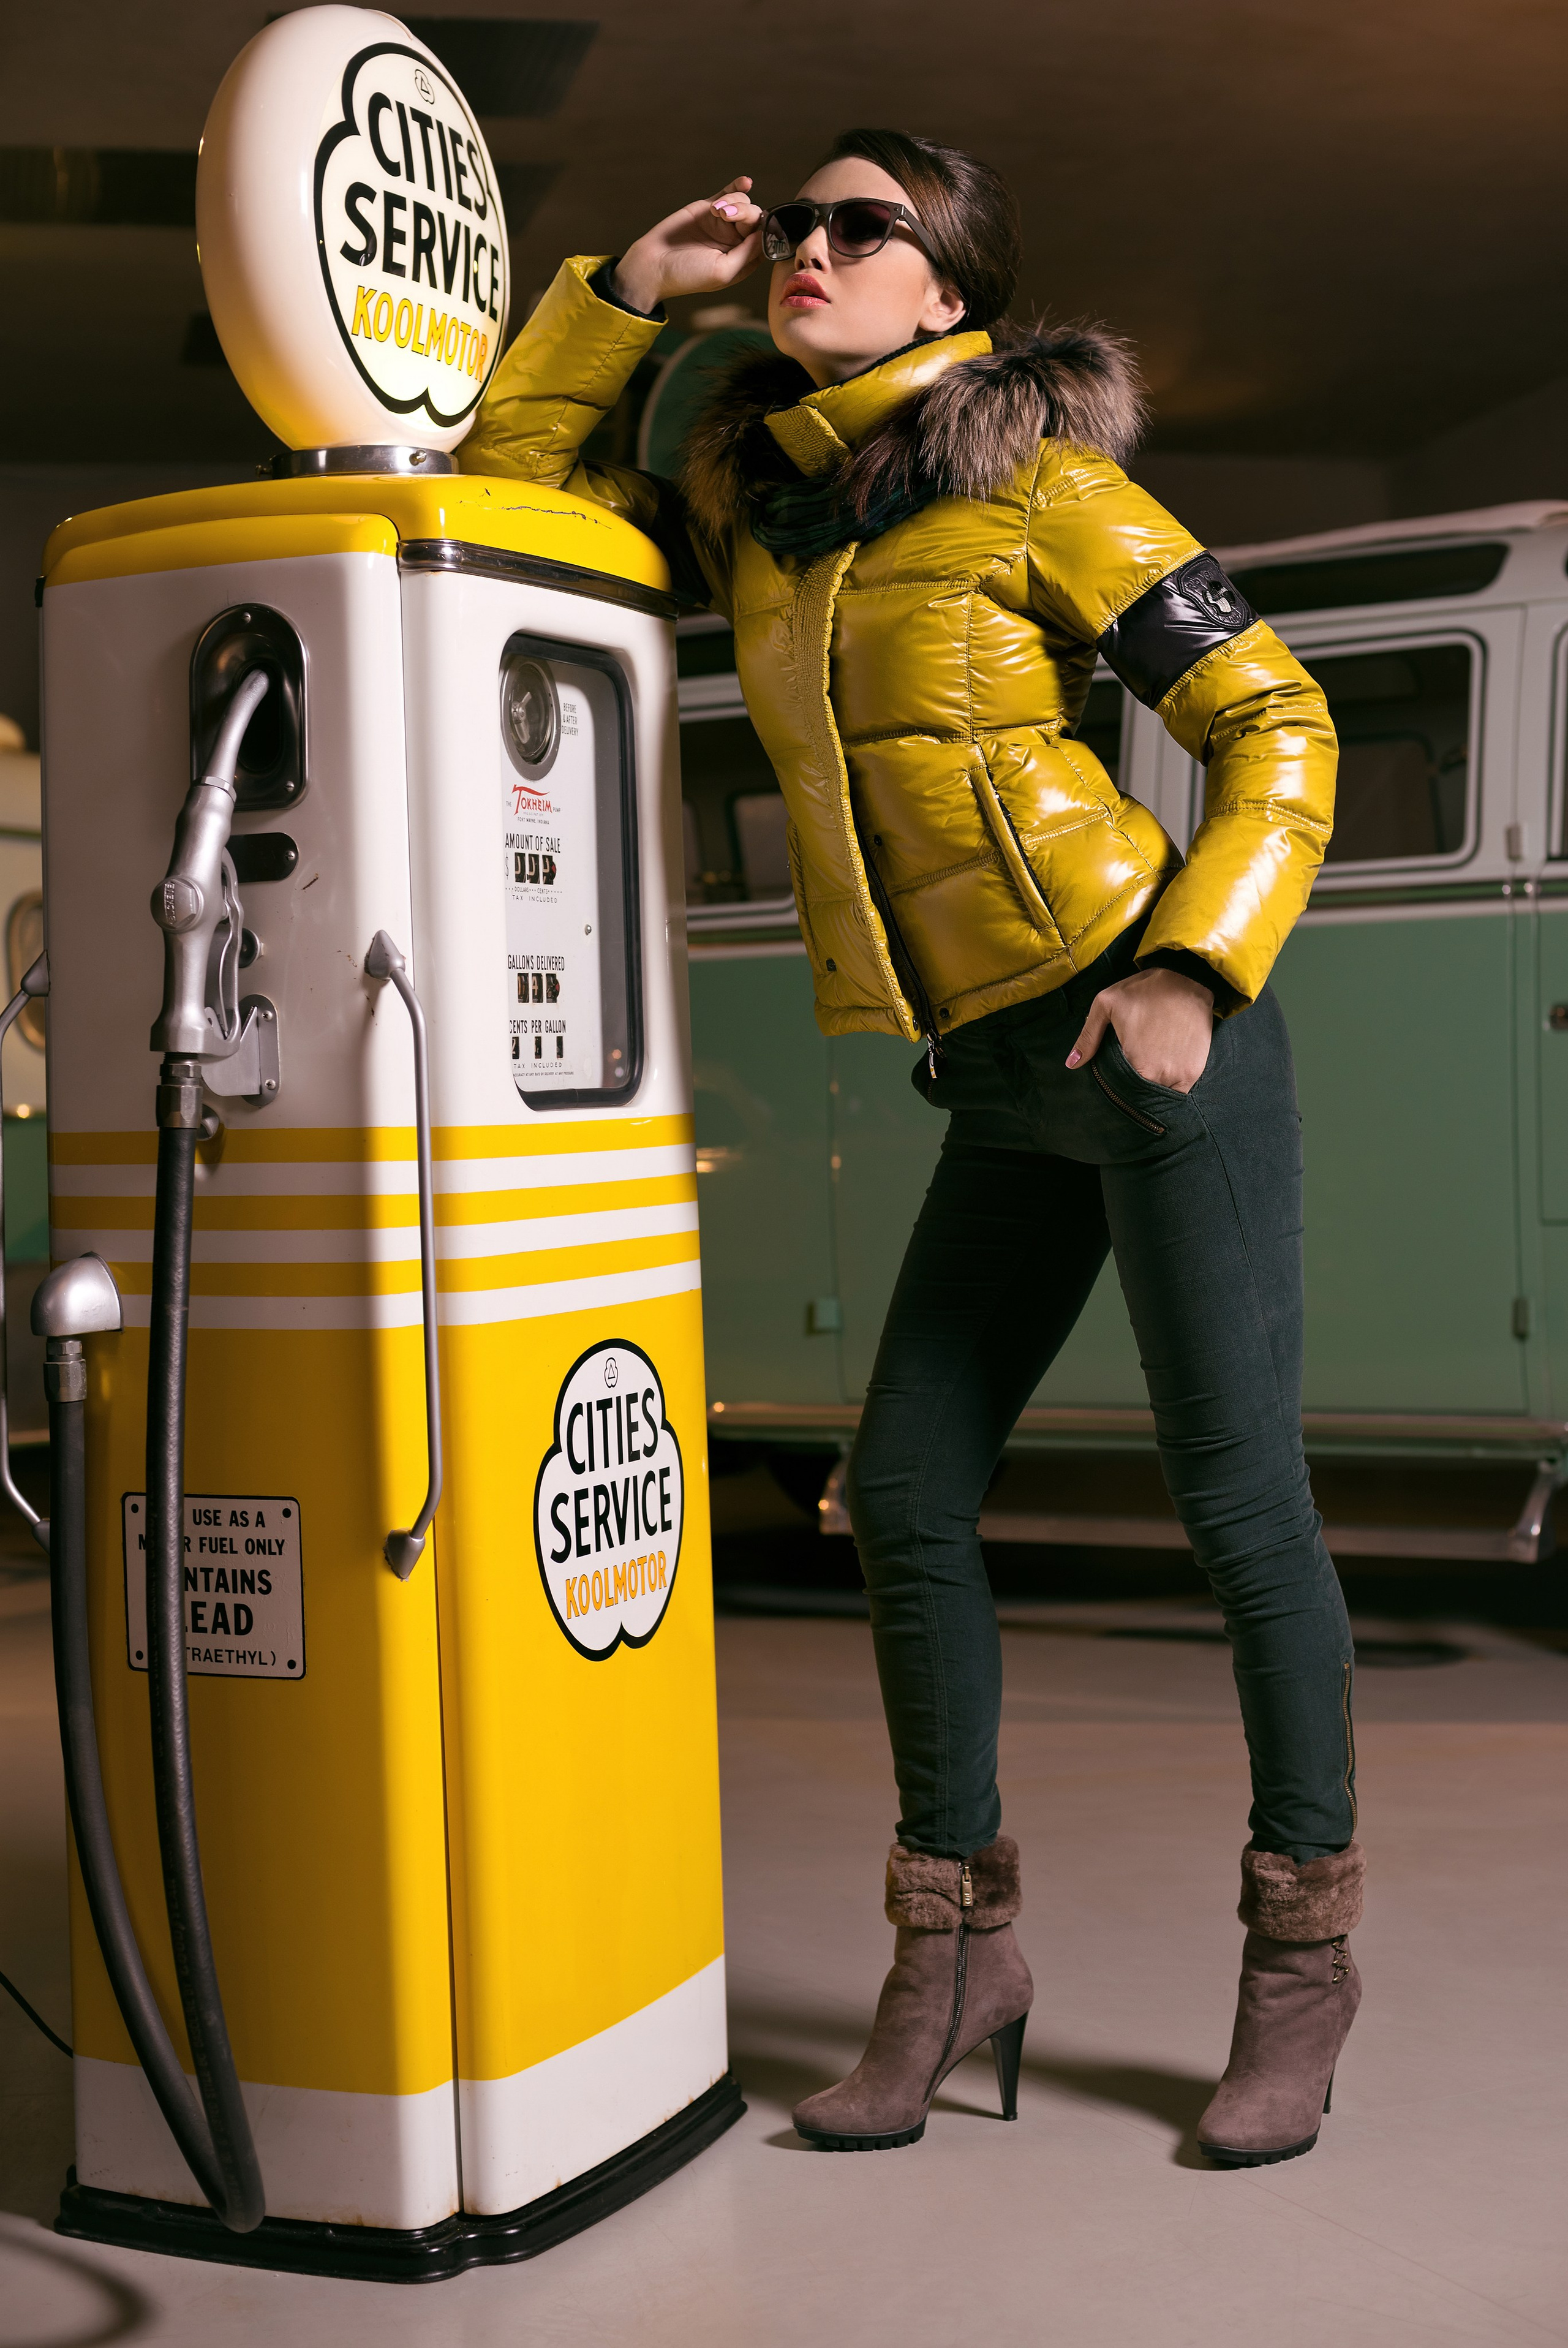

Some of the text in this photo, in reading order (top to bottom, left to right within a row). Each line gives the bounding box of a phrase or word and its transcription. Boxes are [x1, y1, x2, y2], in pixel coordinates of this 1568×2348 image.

[368, 91, 488, 221] CITIES
[339, 181, 500, 324] SERVICE
[352, 285, 488, 383] KOOLMOTOR
[564, 703, 576, 713] BEFORE
[566, 715, 578, 725] AFTER
[562, 725, 578, 736] DELIVERY
[511, 784, 552, 815] TOKHEIM
[505, 833, 560, 853] AMOUNT OF SALE
[508, 954, 565, 971] GALLONS DELIVERED
[531, 1019, 542, 1033] PER
[545, 1019, 566, 1033] GALLON
[567, 1387, 658, 1475] CITIES
[192, 1509, 266, 1528] USE AS A
[550, 1466, 673, 1563] SERVICE
[199, 1536, 238, 1554] FUEL
[244, 1538, 285, 1555] ONLY
[184, 1567, 272, 1595] NTAINS
[565, 1550, 668, 1620] KOOLMOTOR
[185, 1601, 253, 1636] EAD
